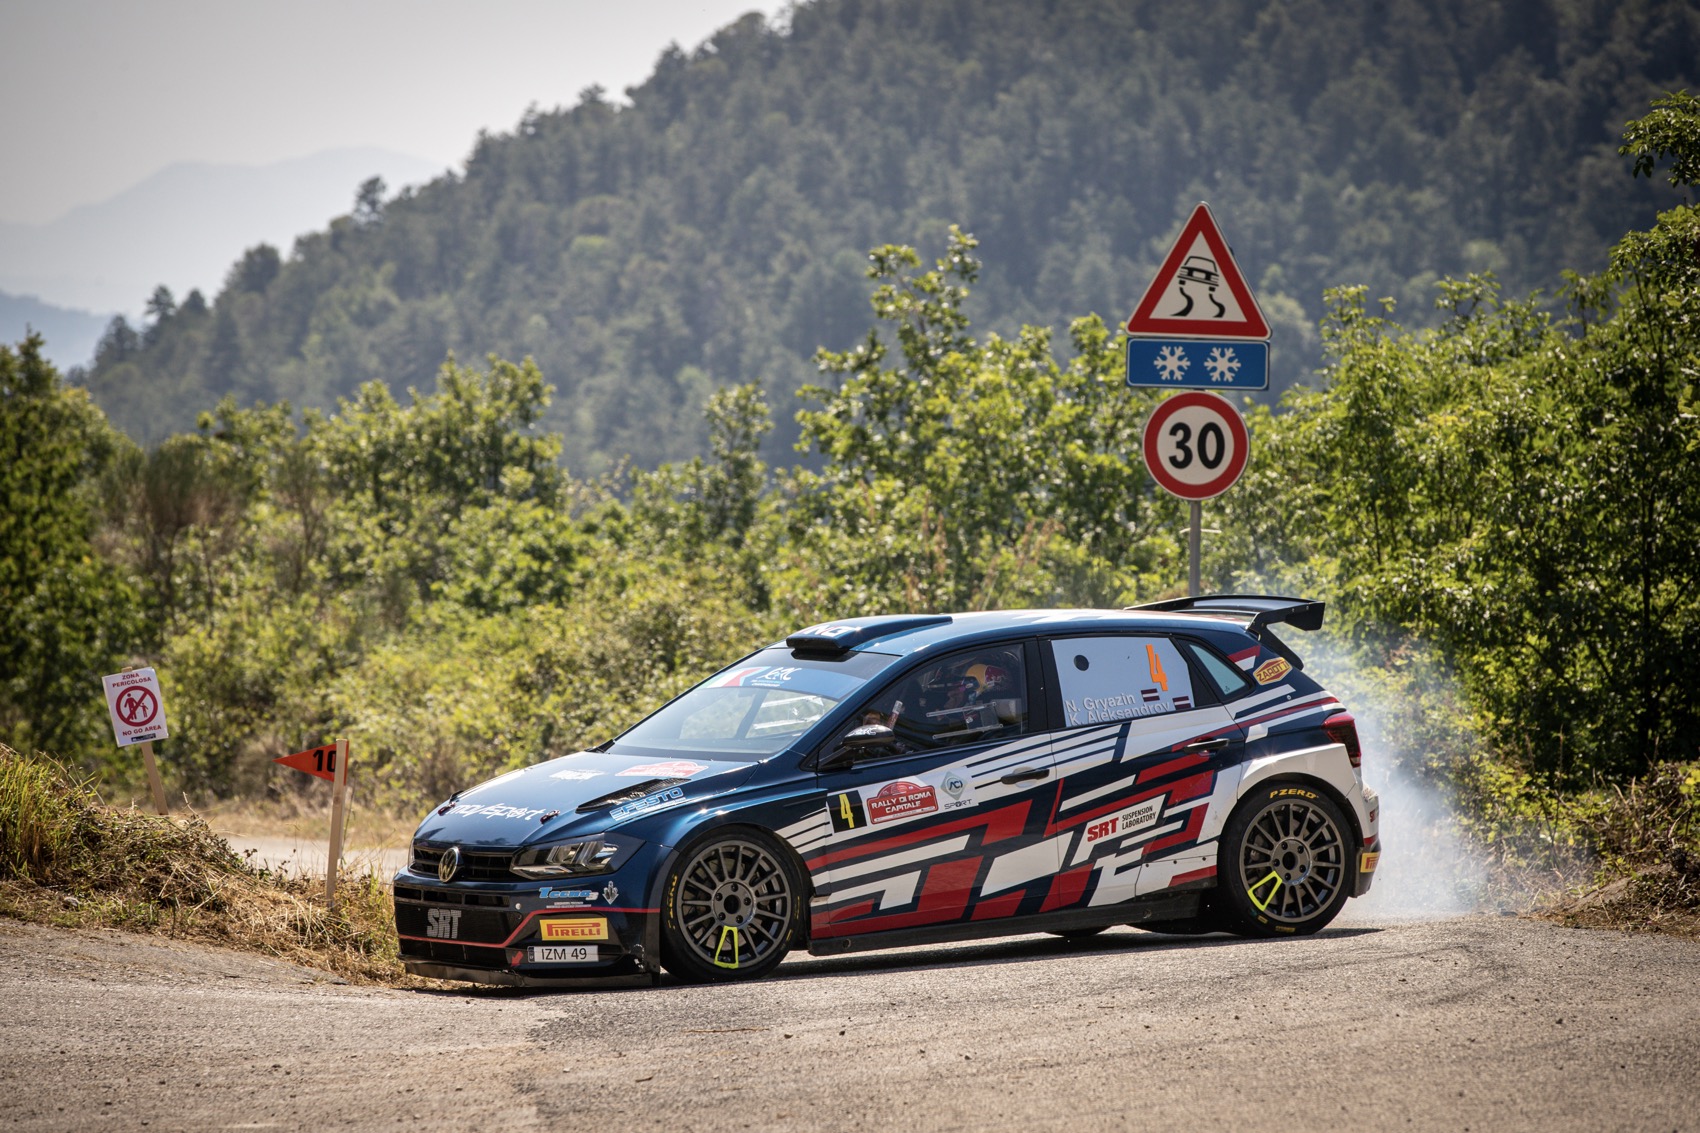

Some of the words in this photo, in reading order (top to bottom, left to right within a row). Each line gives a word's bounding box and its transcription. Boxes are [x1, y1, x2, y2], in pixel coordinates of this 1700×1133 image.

[1168, 421, 1225, 470] 30
[1145, 643, 1169, 692] 4
[1256, 661, 1290, 681] ZAROTTI
[112, 676, 152, 688] PERICOLOSA
[1065, 700, 1081, 713] N.
[1083, 692, 1136, 712] Gryazin
[1069, 712, 1082, 726] K.
[1088, 701, 1170, 724] Aleksandrov
[948, 781, 964, 790] ACI
[871, 797, 897, 809] RALLY
[908, 791, 932, 802] ROMA
[885, 800, 921, 814] CAPITALE
[944, 798, 972, 810] SPORT
[838, 793, 855, 829] 4
[1122, 805, 1153, 822] SUSPENSION
[1087, 816, 1119, 842] SRT
[1122, 812, 1156, 830] LABORATORY
[426, 908, 462, 939] SRT
[546, 922, 602, 936] PIRELLI
[541, 948, 566, 960] IZM
[570, 948, 587, 960] 49
